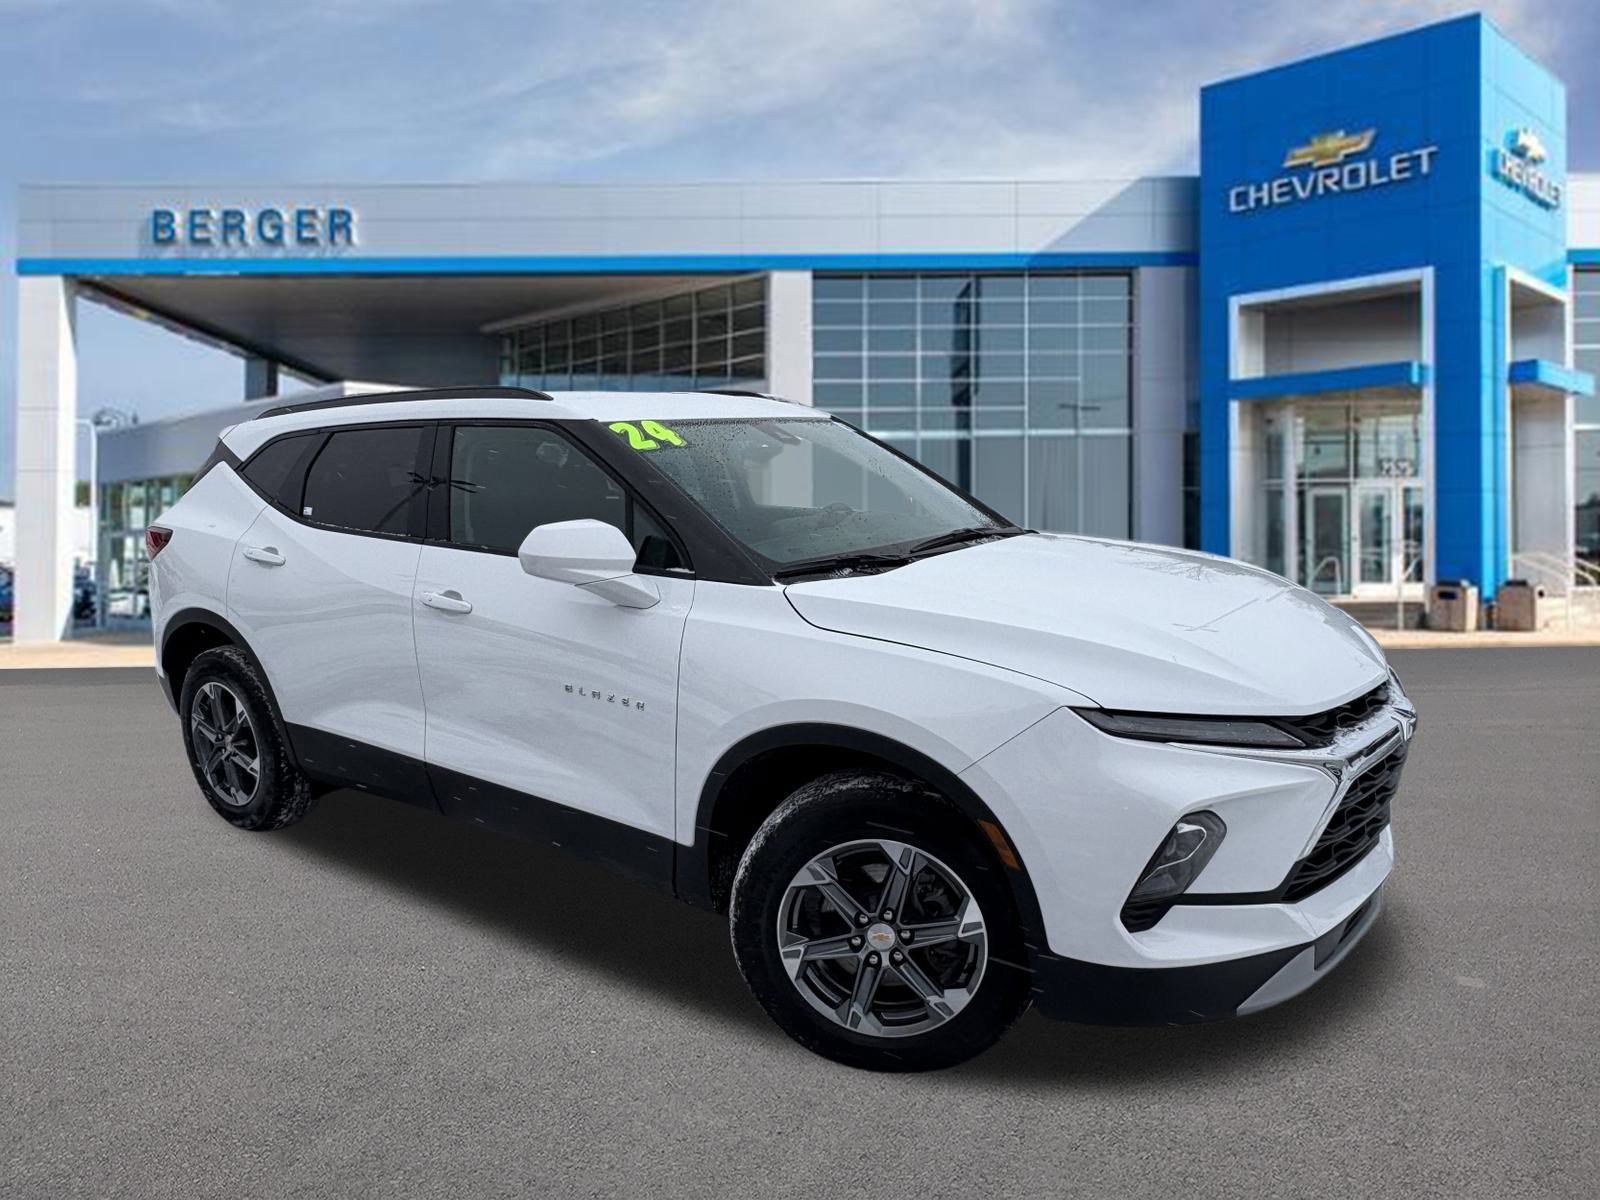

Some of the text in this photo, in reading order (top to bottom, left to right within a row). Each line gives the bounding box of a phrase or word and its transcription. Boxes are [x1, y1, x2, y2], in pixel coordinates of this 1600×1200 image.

[1229, 146, 1438, 212] CHEVROLET
[152, 208, 354, 247] BERGER
[608, 420, 686, 450] 24
[564, 684, 645, 711] BLAZER
